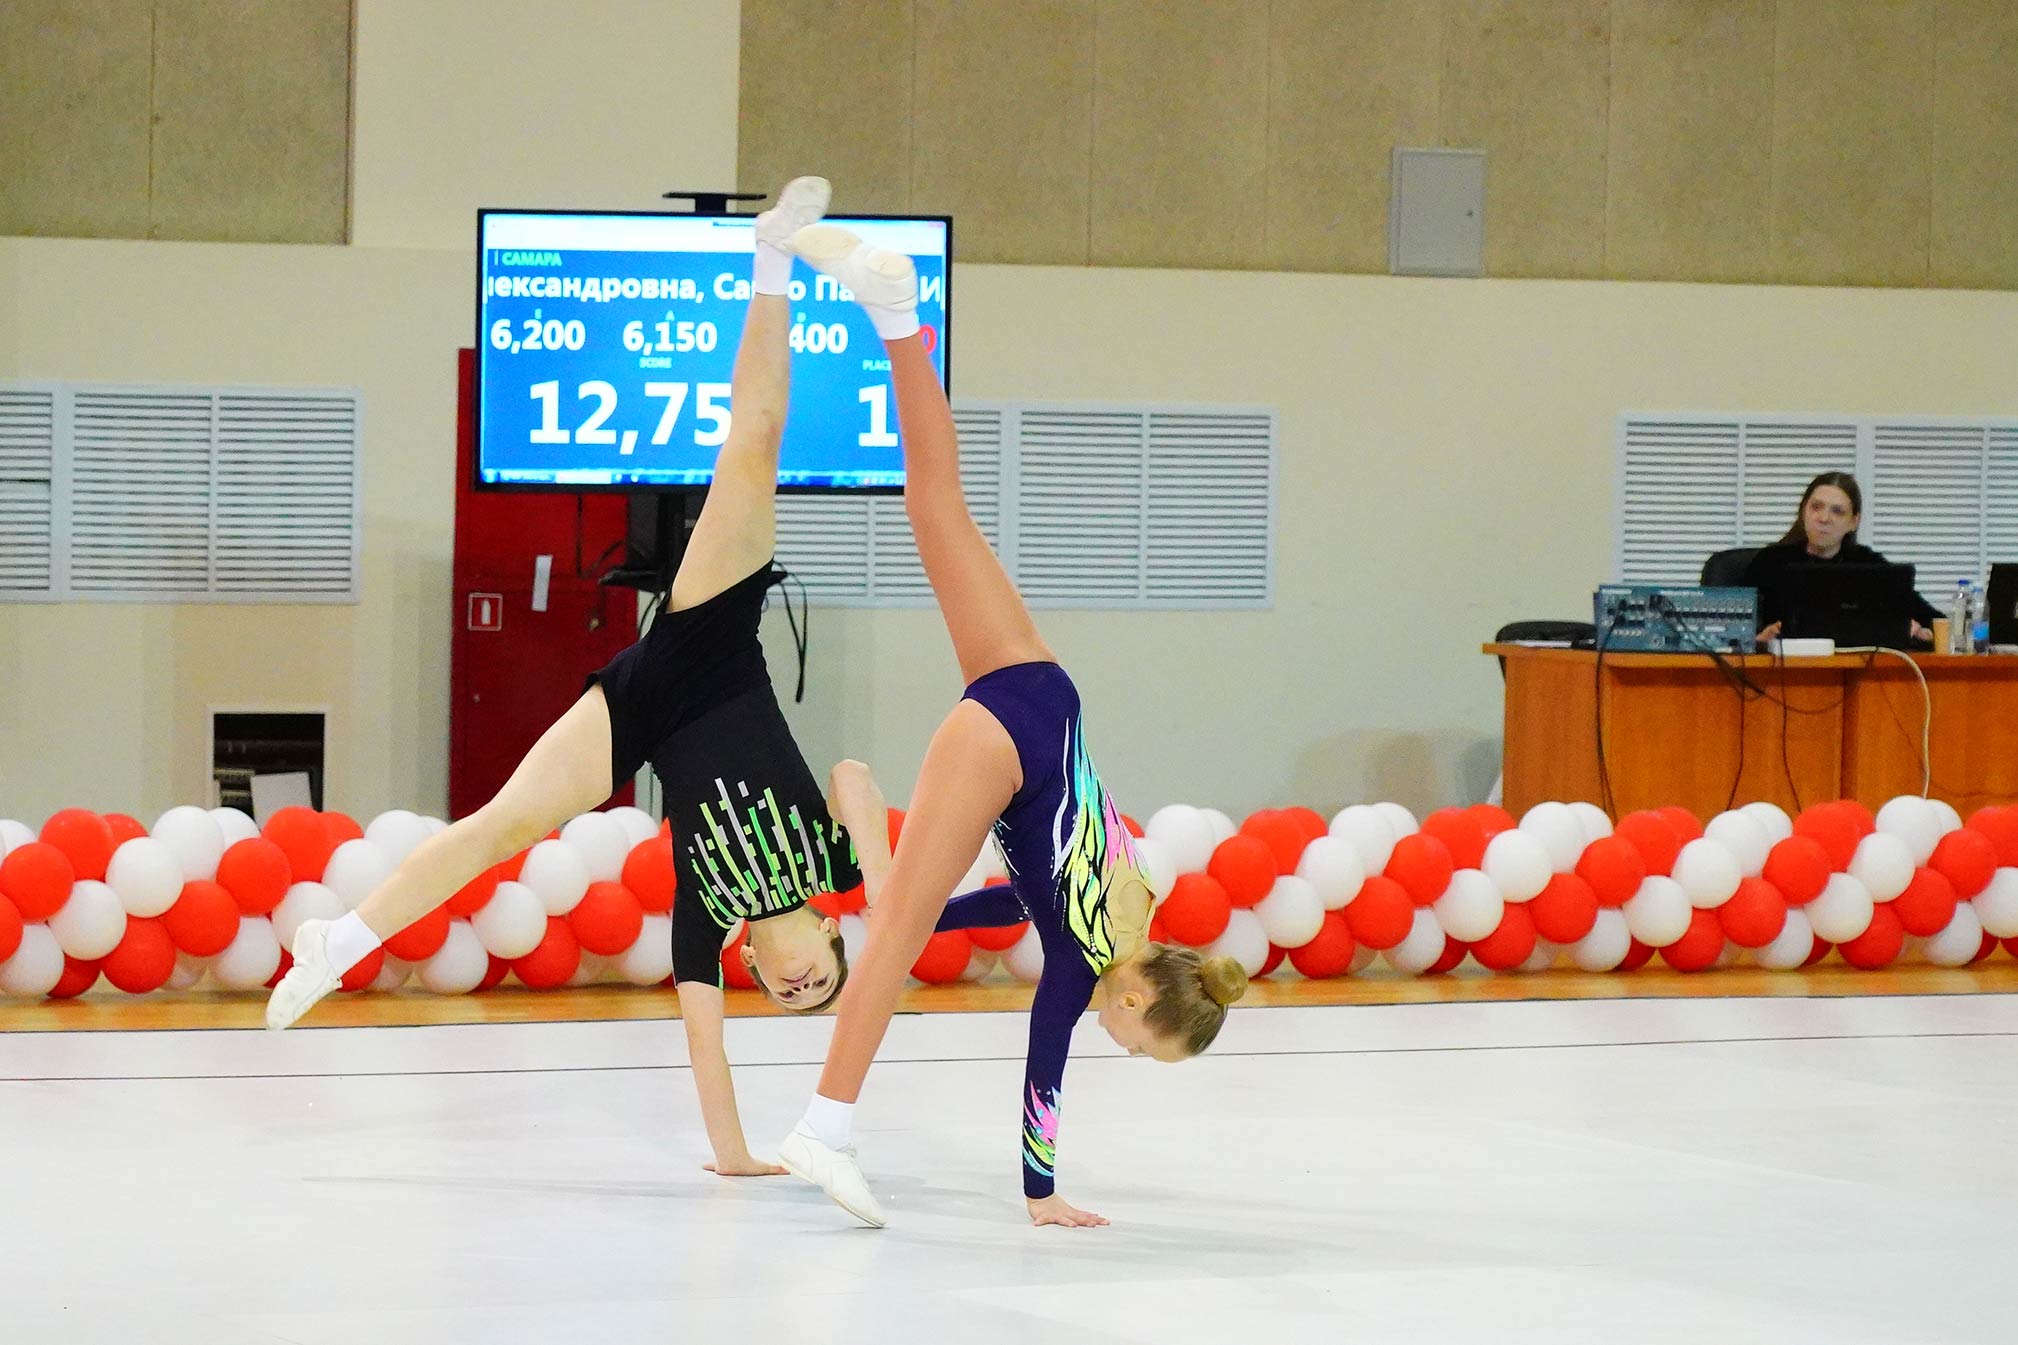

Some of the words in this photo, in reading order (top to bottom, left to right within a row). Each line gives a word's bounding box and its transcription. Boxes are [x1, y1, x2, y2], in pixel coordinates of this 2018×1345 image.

[501, 251, 562, 266] САМАРА
[713, 272, 807, 301] Сао
[490, 318, 586, 353] 6,200
[622, 320, 718, 356] 6,150
[789, 322, 849, 354] 400
[639, 357, 672, 369] SCORE
[529, 379, 733, 455] 12,75
[858, 383, 899, 447] 1
